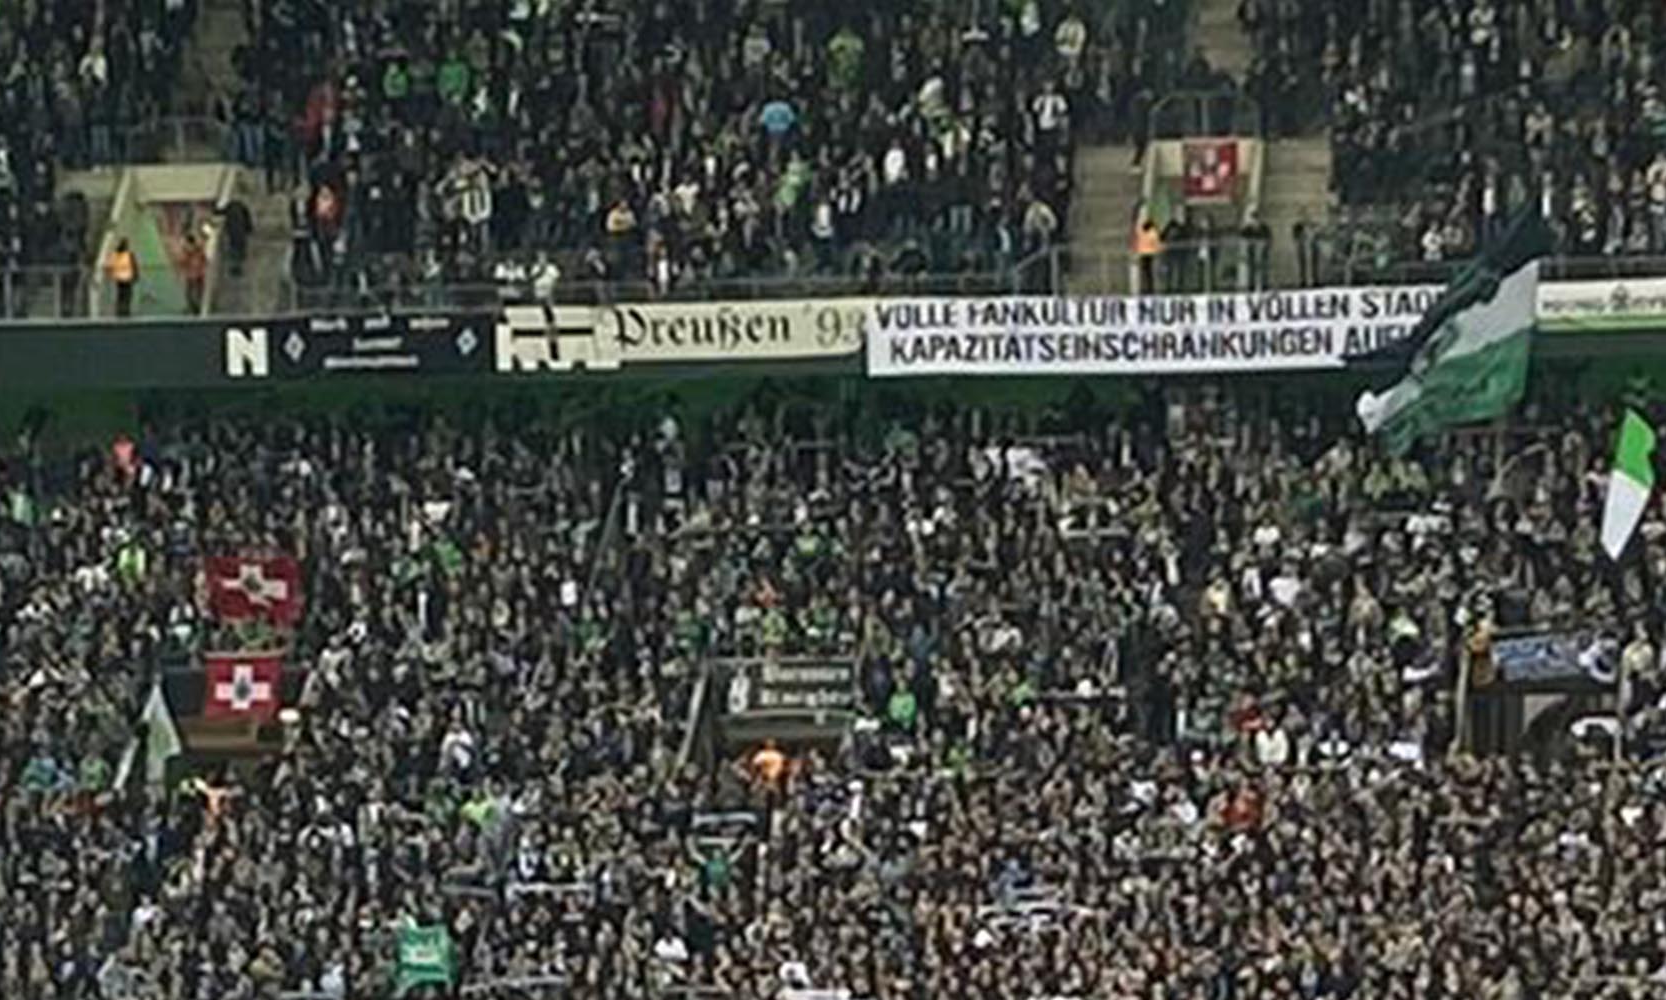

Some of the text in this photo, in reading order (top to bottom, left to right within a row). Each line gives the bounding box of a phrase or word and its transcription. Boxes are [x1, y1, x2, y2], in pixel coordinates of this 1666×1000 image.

[614, 306, 791, 350] Preußen
[874, 302, 957, 330] VOLLE
[967, 299, 1126, 327] FANKULTUR
[1137, 298, 1196, 325] NUR
[1207, 297, 1236, 323] IN
[1247, 292, 1350, 322] VOLLEN
